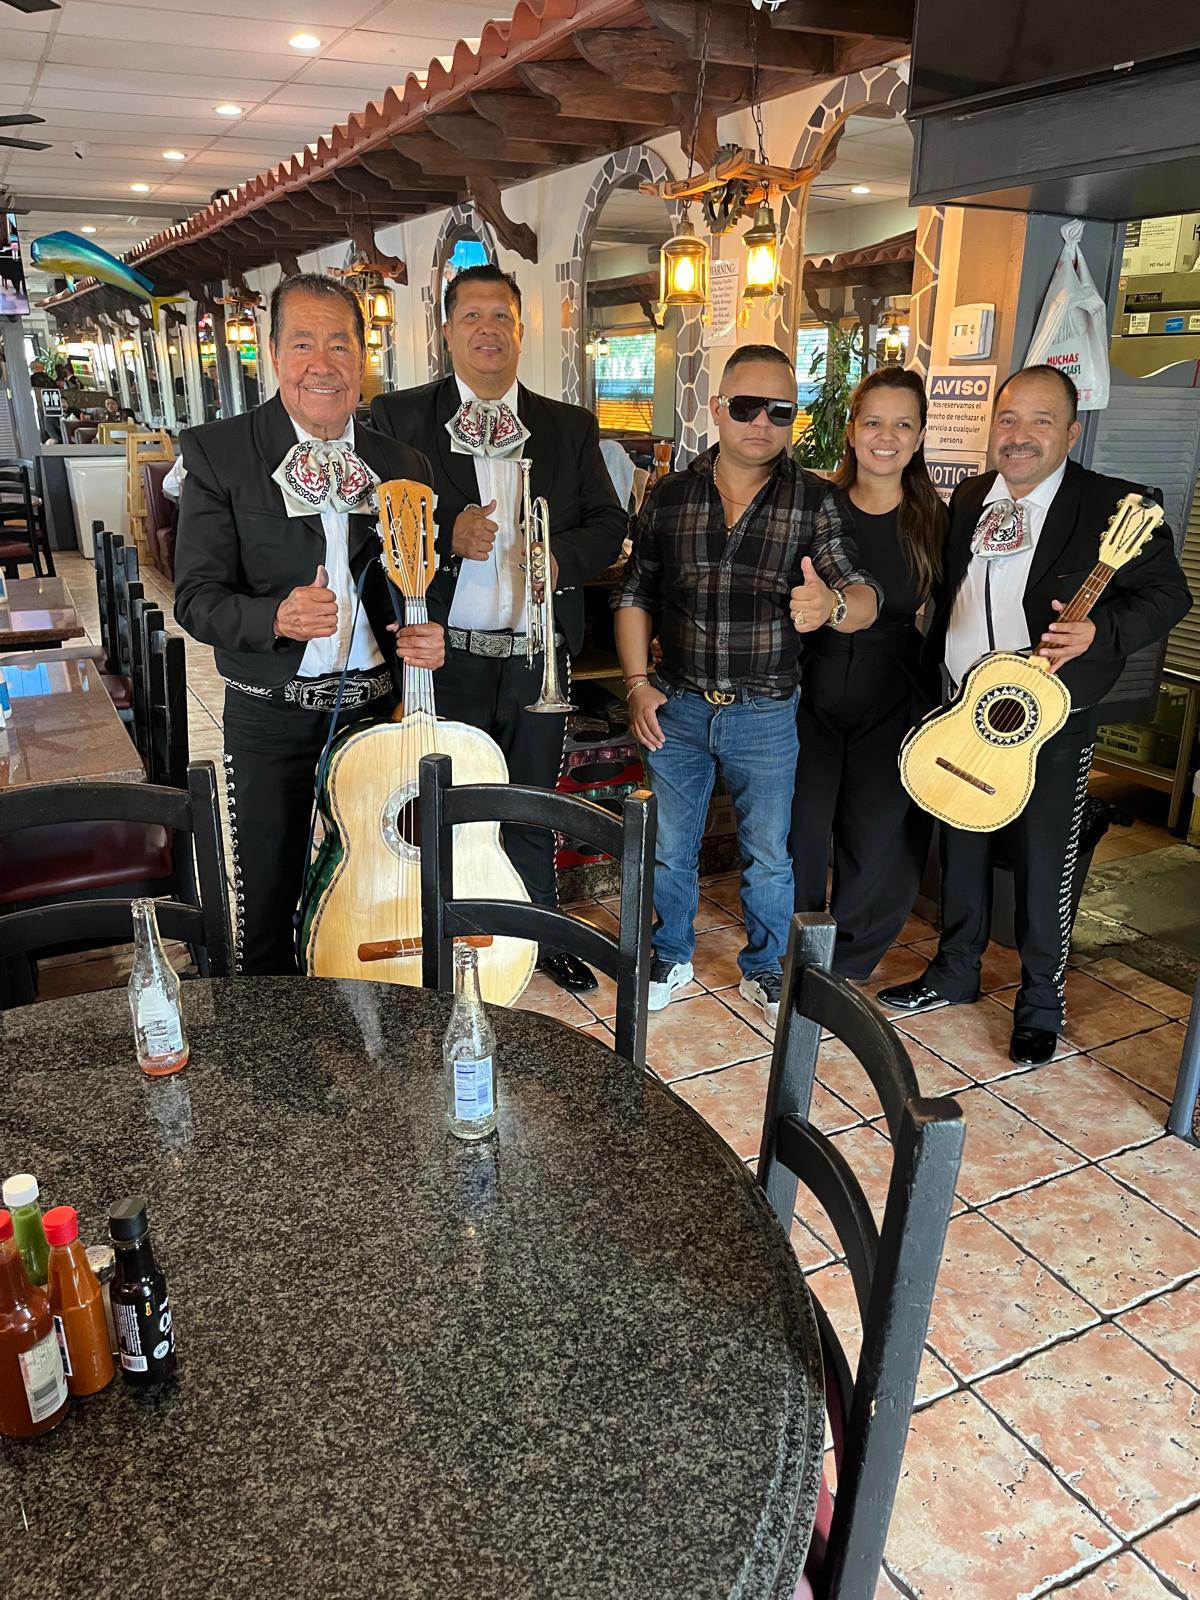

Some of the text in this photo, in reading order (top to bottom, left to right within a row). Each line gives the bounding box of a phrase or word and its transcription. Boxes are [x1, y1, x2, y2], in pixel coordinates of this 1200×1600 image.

[1046, 353, 1079, 365] MUCHAS
[932, 380, 987, 396] AVISO
[954, 413, 979, 421] rechazar
[980, 414, 986, 422] el
[928, 424, 947, 432] servicio
[953, 425, 980, 434] cualquier
